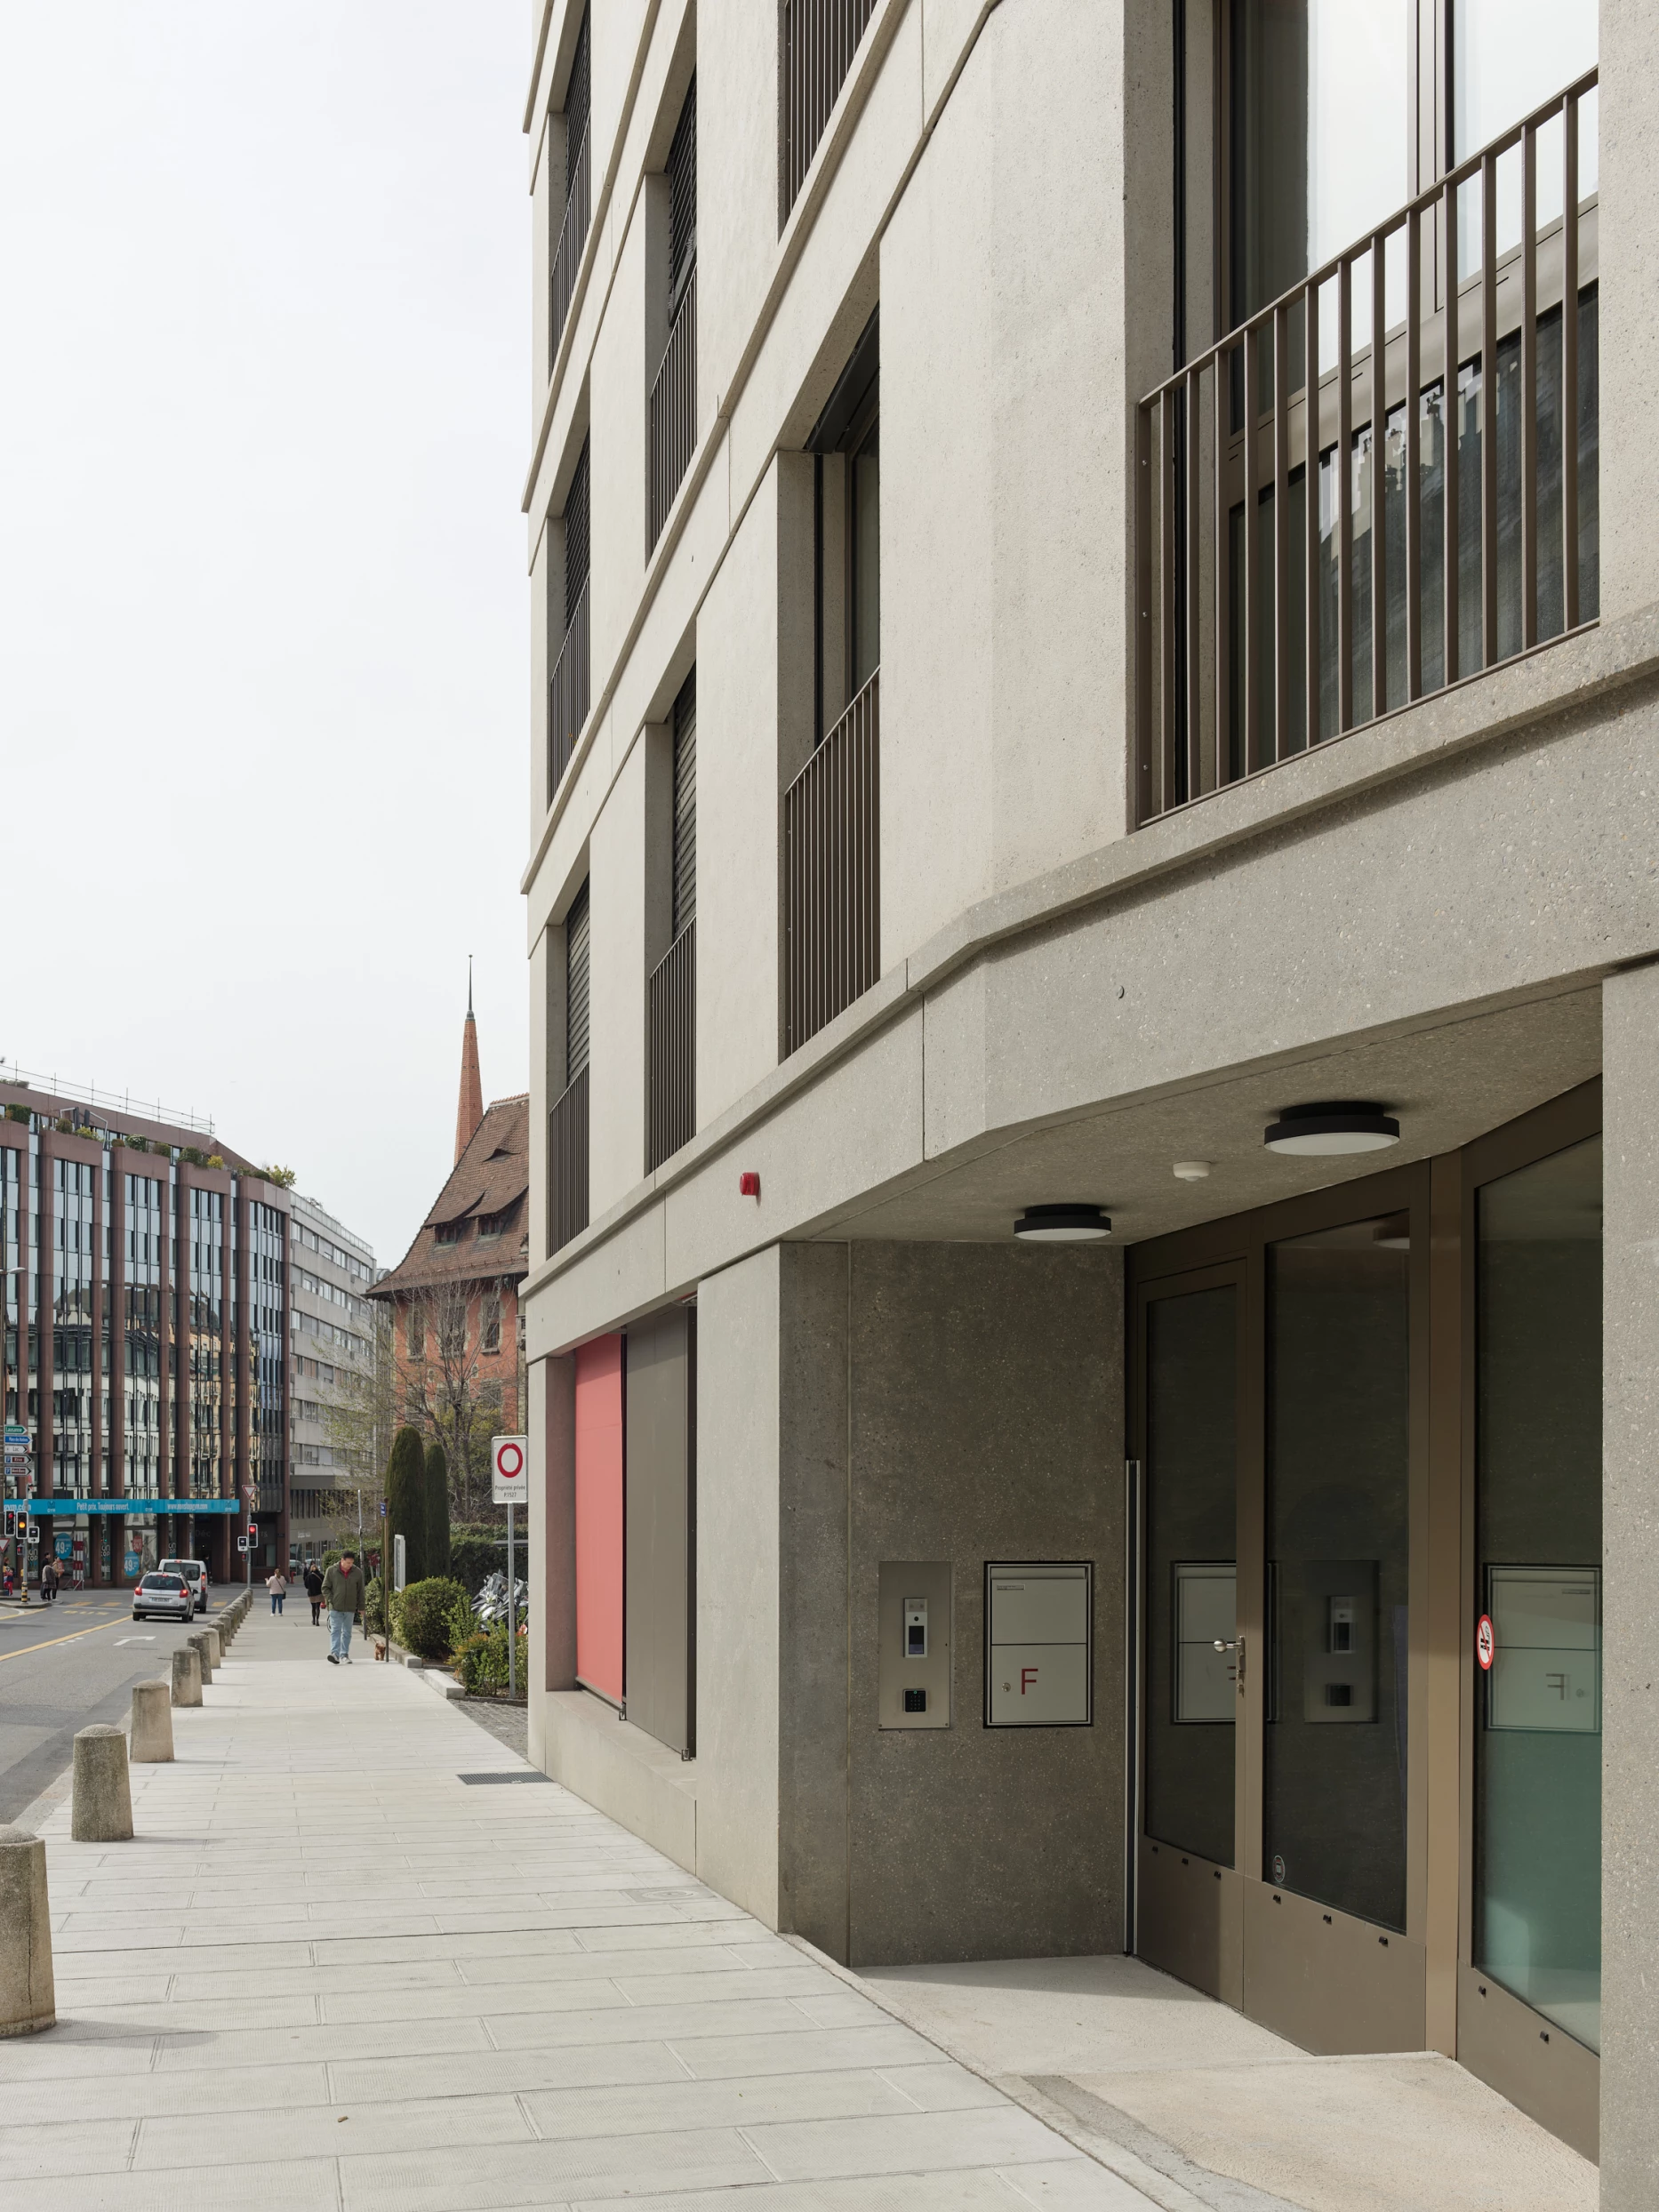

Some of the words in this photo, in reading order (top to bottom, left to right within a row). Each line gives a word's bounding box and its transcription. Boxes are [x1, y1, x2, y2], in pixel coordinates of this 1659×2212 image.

[76, 1503, 87, 1511] Petit
[98, 1502, 115, 1511] Toujours
[1022, 1669, 1038, 1695] F
